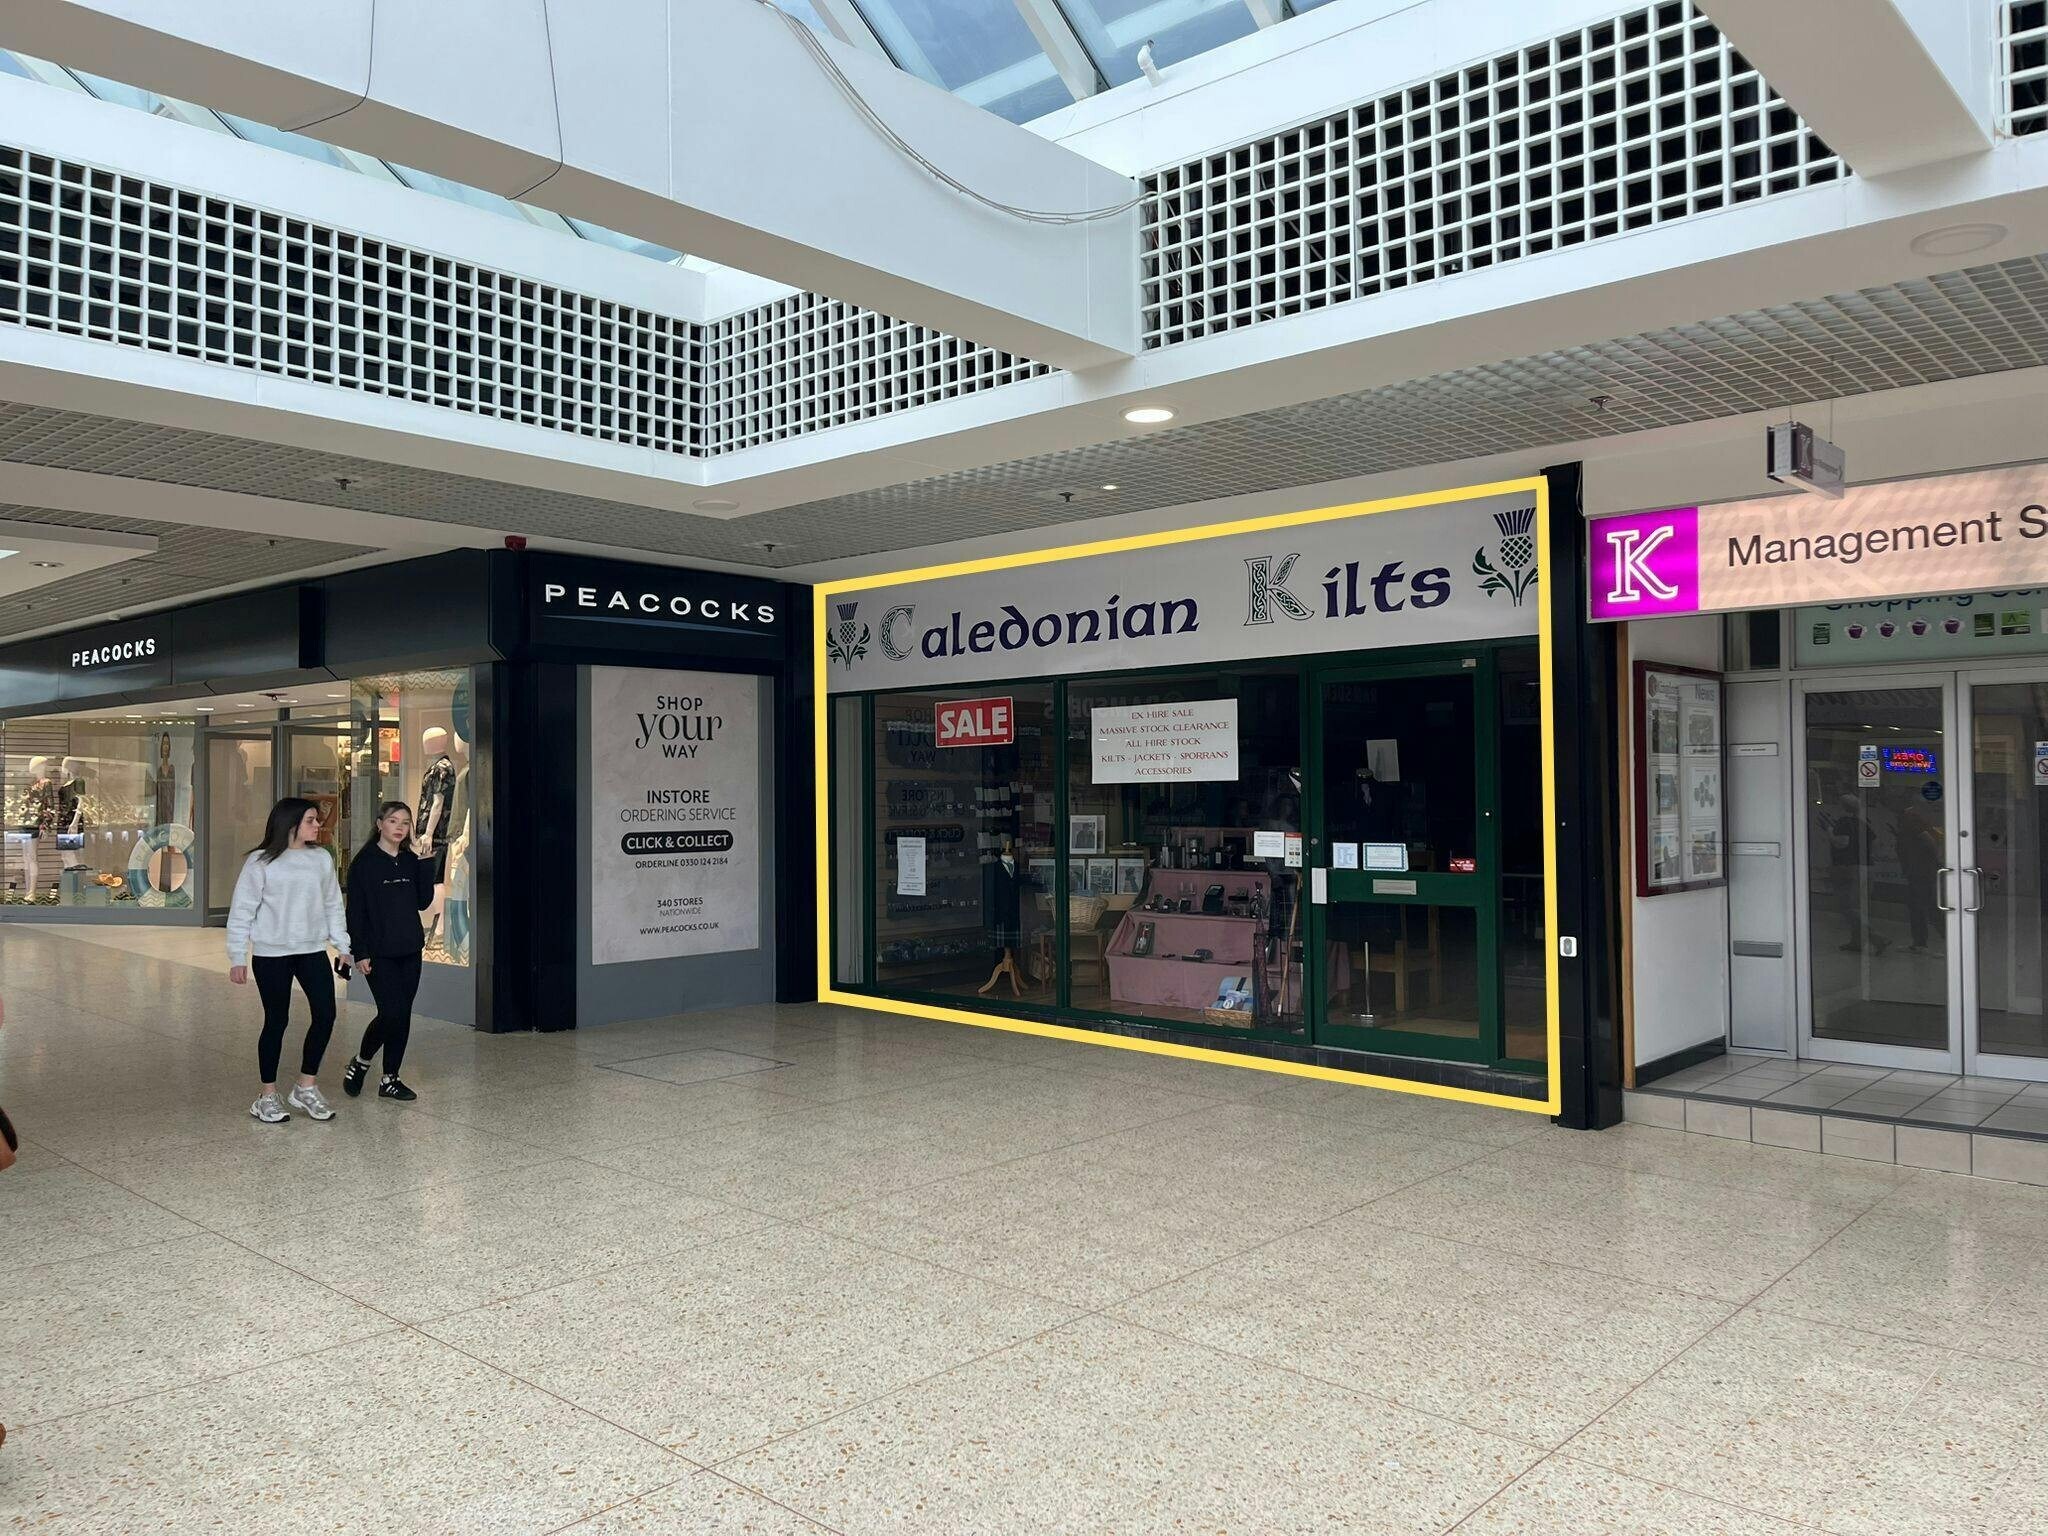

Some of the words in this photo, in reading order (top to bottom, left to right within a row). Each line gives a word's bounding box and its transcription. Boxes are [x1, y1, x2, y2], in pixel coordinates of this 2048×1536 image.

[1728, 511, 2002, 567] Management
[1607, 525, 1678, 602] K
[545, 583, 775, 623] PEACOCKS
[879, 594, 1200, 661] Caledonian
[1244, 553, 1451, 626] Kilts
[72, 638, 155, 668] PEACOCKS
[657, 695, 703, 711] SHOP
[1131, 711, 1144, 720] EX
[1147, 710, 1170, 719] HIRE
[1172, 708, 1194, 718] SALE
[940, 706, 1008, 739] SALE
[1100, 726, 1137, 736] MASSIVE
[1140, 724, 1170, 733] STOCK
[1172, 721, 1229, 732] CLEARANCE
[635, 713, 723, 749] your
[1126, 739, 1142, 748] ALL
[1145, 738, 1168, 747] HIRE
[1171, 737, 1201, 746] STOCK
[662, 744, 698, 758] WAY
[1101, 754, 1126, 763] KILTS
[1133, 753, 1171, 763] JACKETS
[1180, 751, 1229, 760] SPORRANS
[1134, 766, 1192, 776] ACCESSORIES
[647, 790, 710, 804] INSTORE
[620, 808, 686, 822] ORDERING
[689, 807, 736, 821] SERVICE
[626, 837, 663, 850] CLICK
[665, 837, 675, 849] &
[676, 834, 729, 848] COLLECT
[635, 859, 679, 869] ORDERLINE
[680, 858, 699, 867] 0330
[673, 897, 703, 907] STORES
[660, 906, 702, 917] NATIONWIDE
[640, 921, 719, 935] WWW.PEACOCKS.CO.UK
